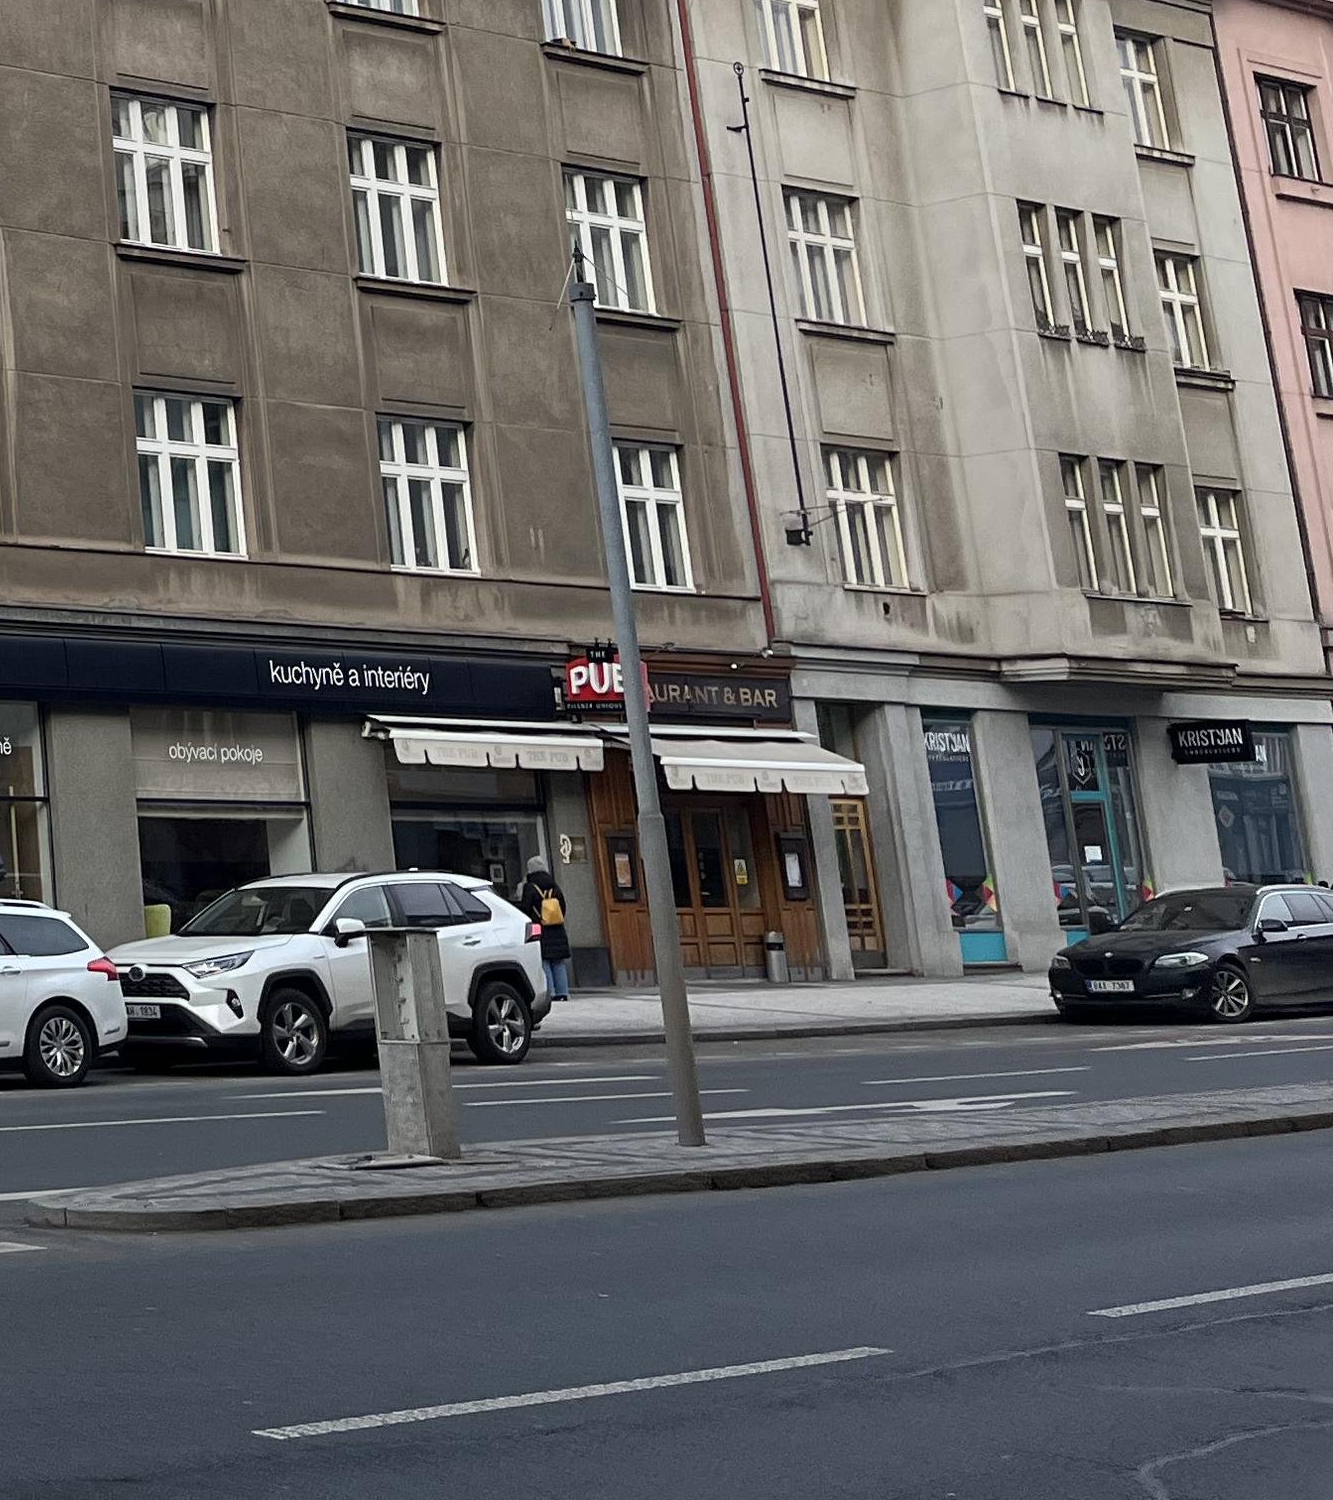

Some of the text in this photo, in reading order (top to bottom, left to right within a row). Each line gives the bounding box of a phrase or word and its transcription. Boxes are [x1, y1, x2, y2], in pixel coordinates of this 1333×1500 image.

[269, 659, 430, 696] kuchyně a interiéry
[723, 686, 737, 705] &
[739, 687, 778, 708] BAR
[1178, 727, 1244, 748] KRISTYAN
[168, 742, 264, 766] obývací pokoje
